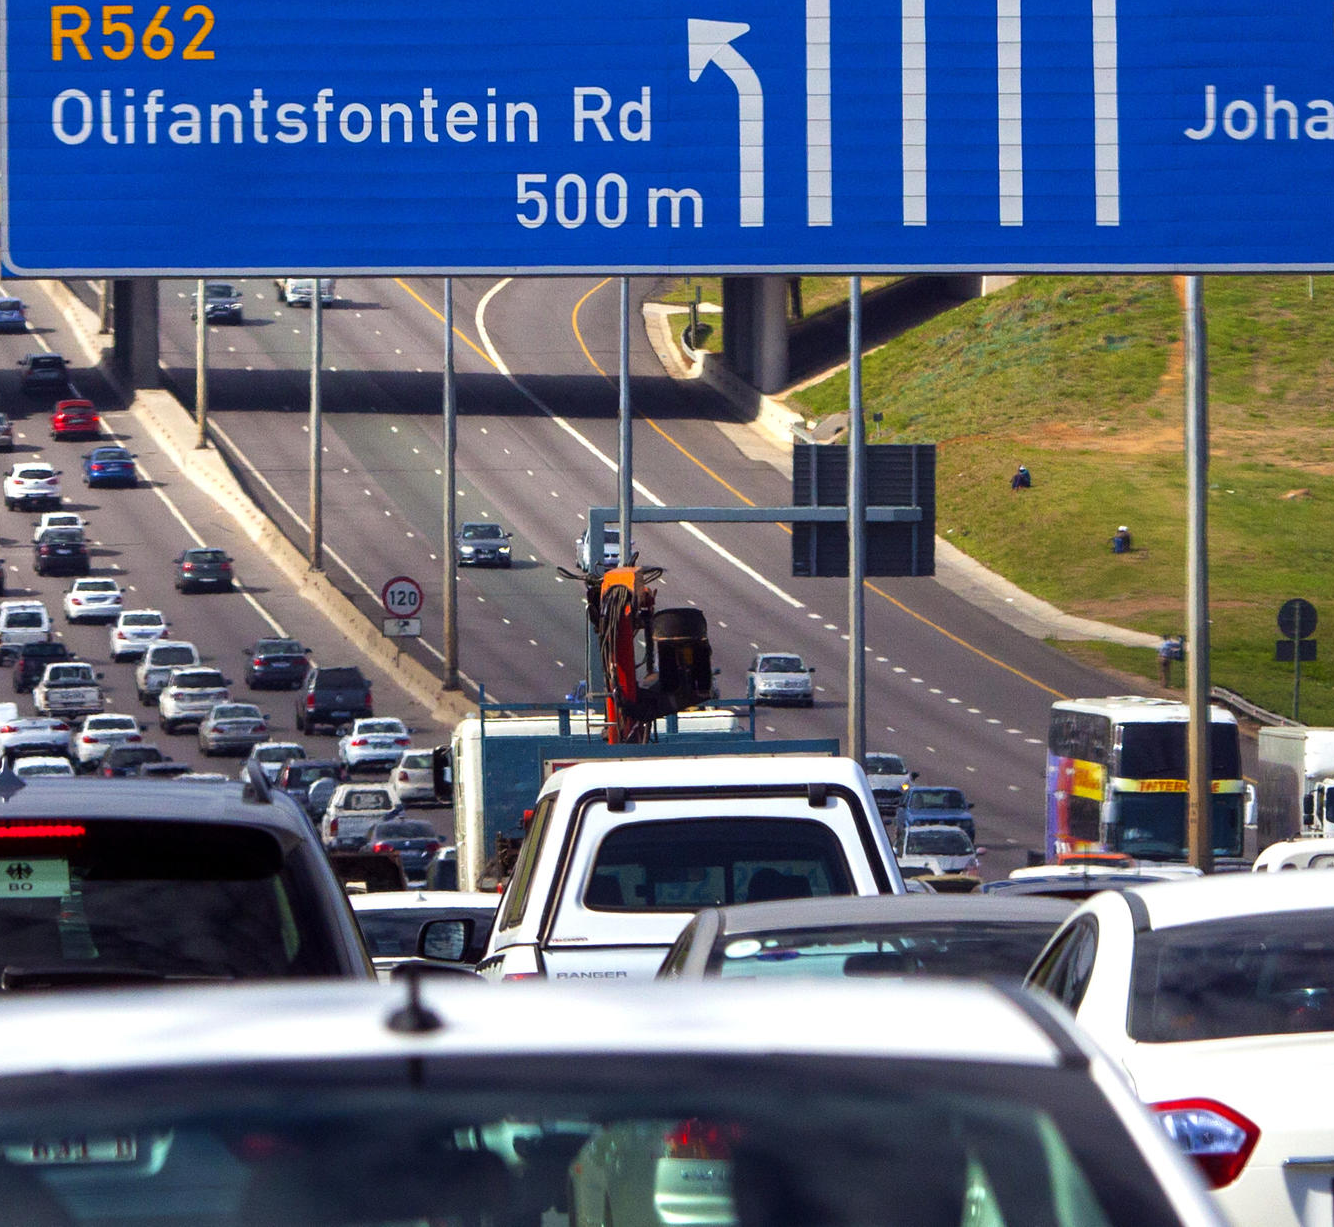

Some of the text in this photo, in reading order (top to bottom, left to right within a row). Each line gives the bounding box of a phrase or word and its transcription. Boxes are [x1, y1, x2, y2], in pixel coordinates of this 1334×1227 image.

[51, 5, 214, 60] R562
[53, 87, 650, 144] Olifantsfontein Rd
[517, 173, 702, 228] 500 m
[390, 590, 417, 606] 120
[556, 971, 627, 979] RANGER
